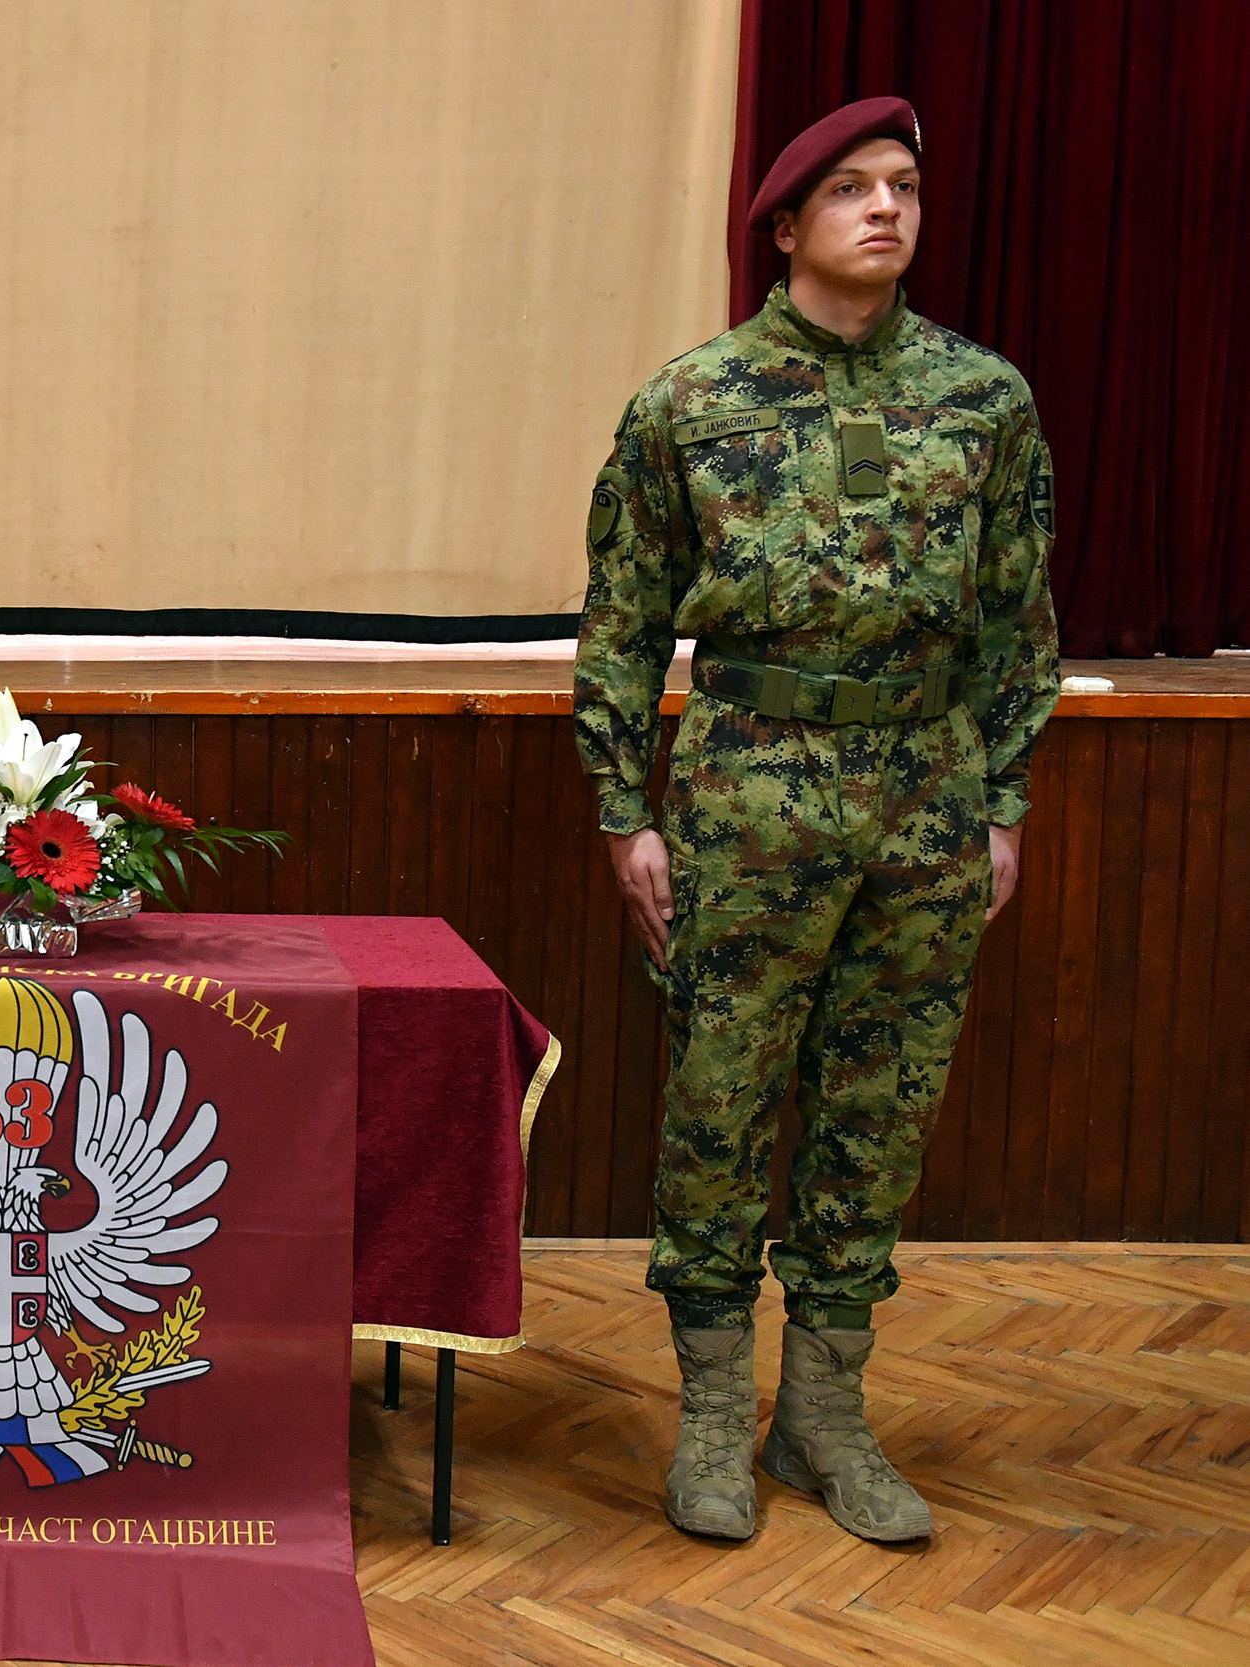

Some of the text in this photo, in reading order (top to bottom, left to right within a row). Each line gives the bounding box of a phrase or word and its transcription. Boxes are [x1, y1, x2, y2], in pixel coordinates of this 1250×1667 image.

[691, 414, 761, 438] И. ЈАНКОВИЋ
[112, 972, 288, 1053] БРИГАДА
[91, 1517, 278, 1550] ОТАЏБИНЕ
